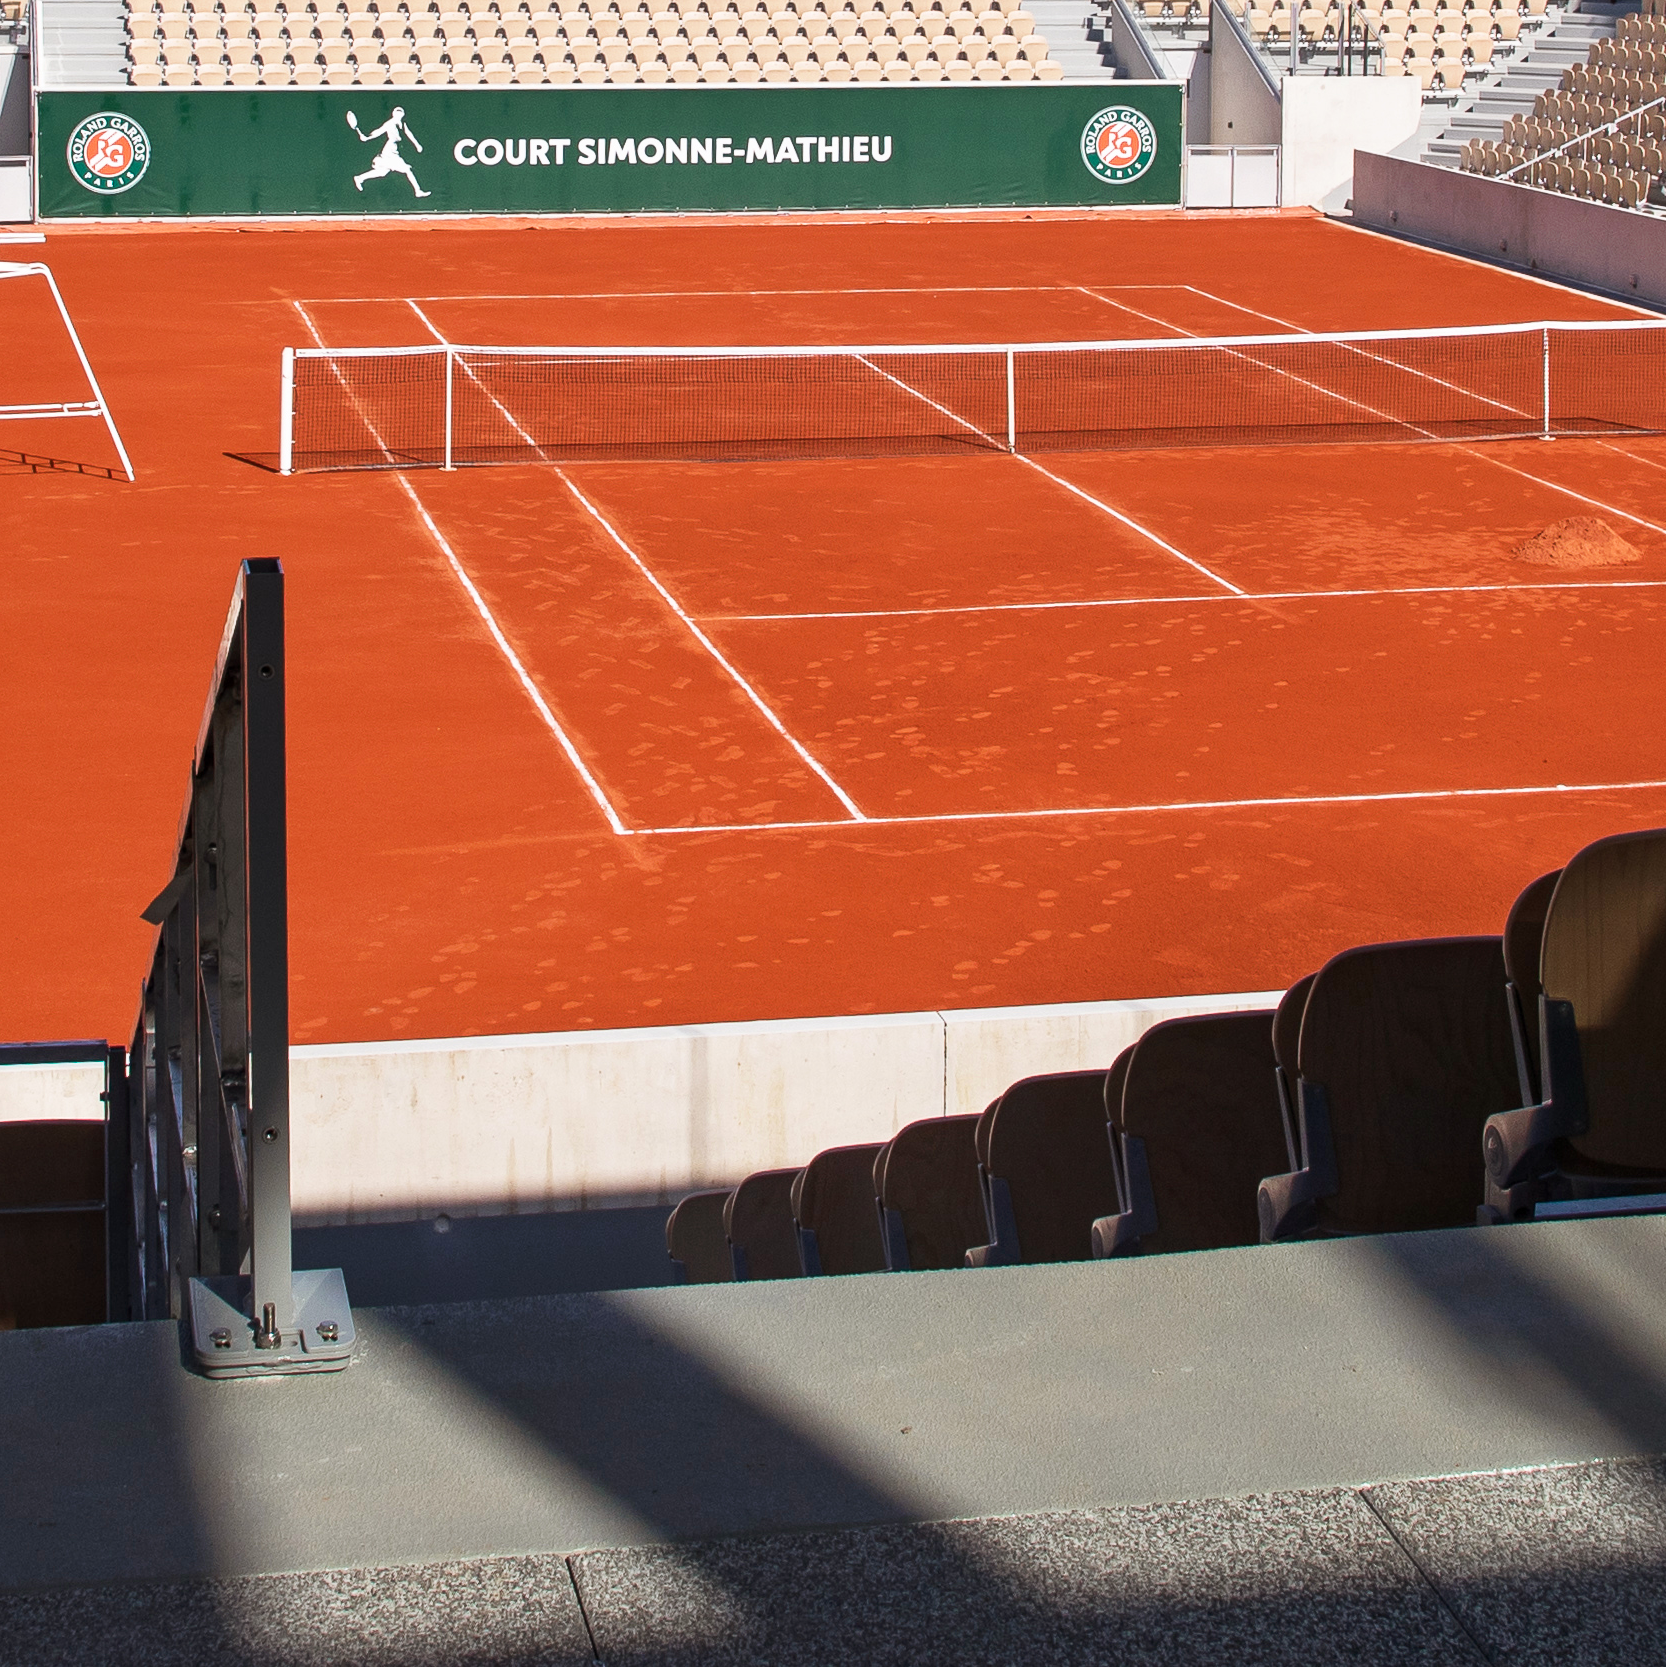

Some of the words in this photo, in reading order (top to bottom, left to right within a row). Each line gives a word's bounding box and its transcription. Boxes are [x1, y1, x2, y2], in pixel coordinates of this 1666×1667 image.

[72, 117, 108, 163] ROLAND
[110, 117, 146, 162] GARROS
[1085, 111, 1118, 154] ROLAND
[1120, 111, 1152, 153] GARROS
[453, 138, 571, 166] COURT
[577, 135, 893, 165] SIMONNE-MATHIEU
[84, 171, 135, 188] PARIS
[1095, 162, 1142, 178] PARIS
